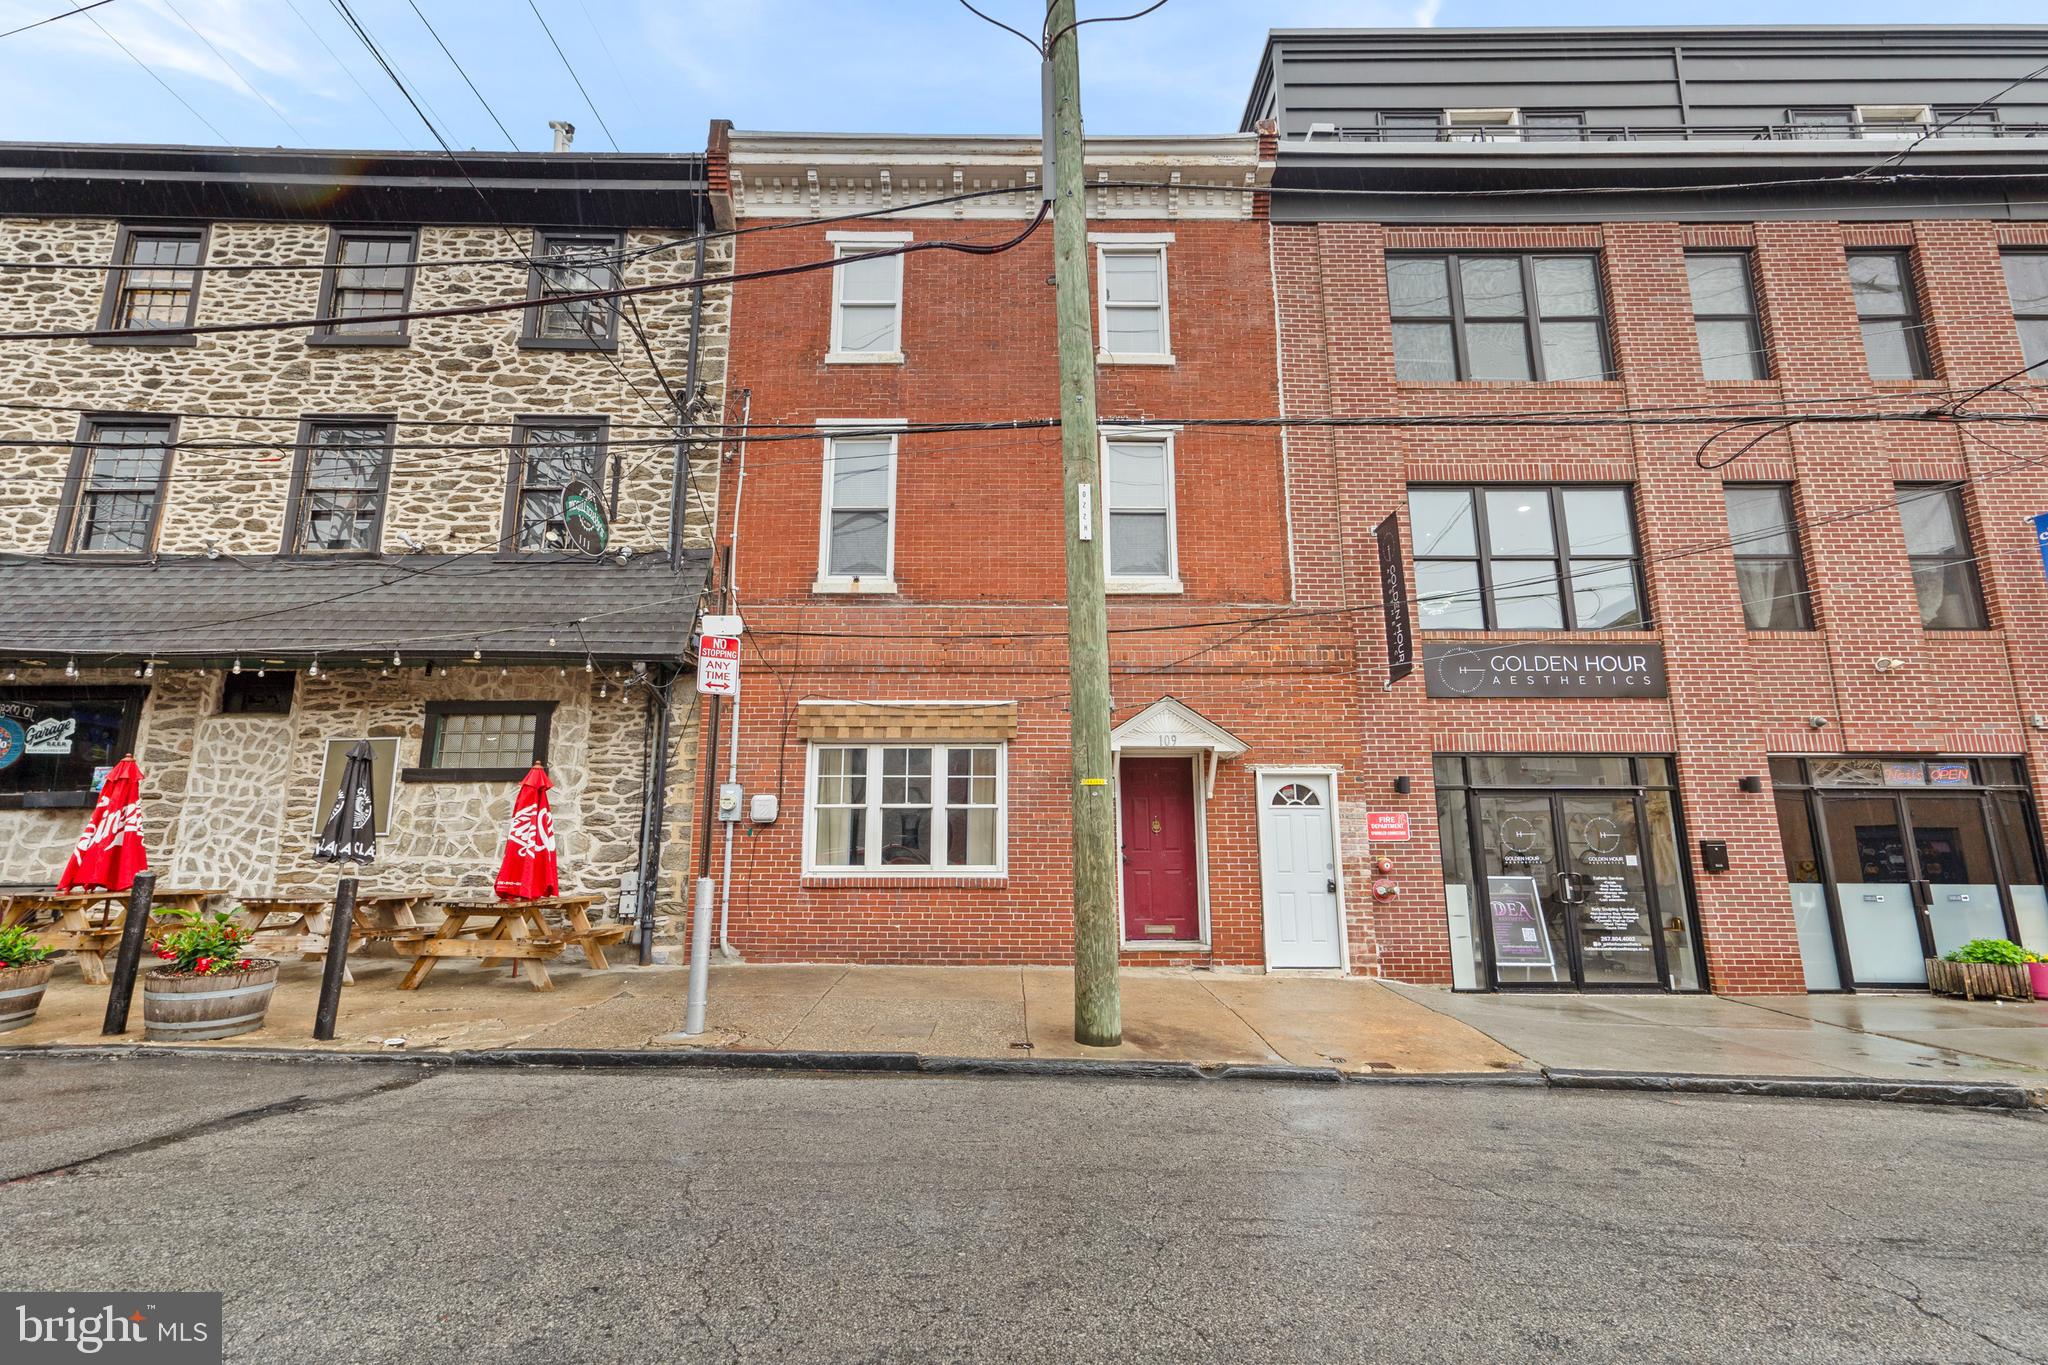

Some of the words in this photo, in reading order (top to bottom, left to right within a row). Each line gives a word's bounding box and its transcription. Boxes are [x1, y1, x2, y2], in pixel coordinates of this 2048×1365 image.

[1389, 564, 1401, 620] GOLDEN
[1396, 622, 1405, 663] HOUR
[713, 638, 727, 649] NO
[702, 648, 737, 659] STOPPING
[705, 660, 731, 670] ANY
[1490, 655, 1578, 672] GOLDEN
[1585, 655, 1647, 672] HOUR
[705, 671, 731, 680] TIME
[1492, 675, 1651, 685] AESTHETICS
[25, 720, 71, 745] Garage
[1159, 734, 1177, 747] 109
[1930, 769, 1969, 780] OPEN
